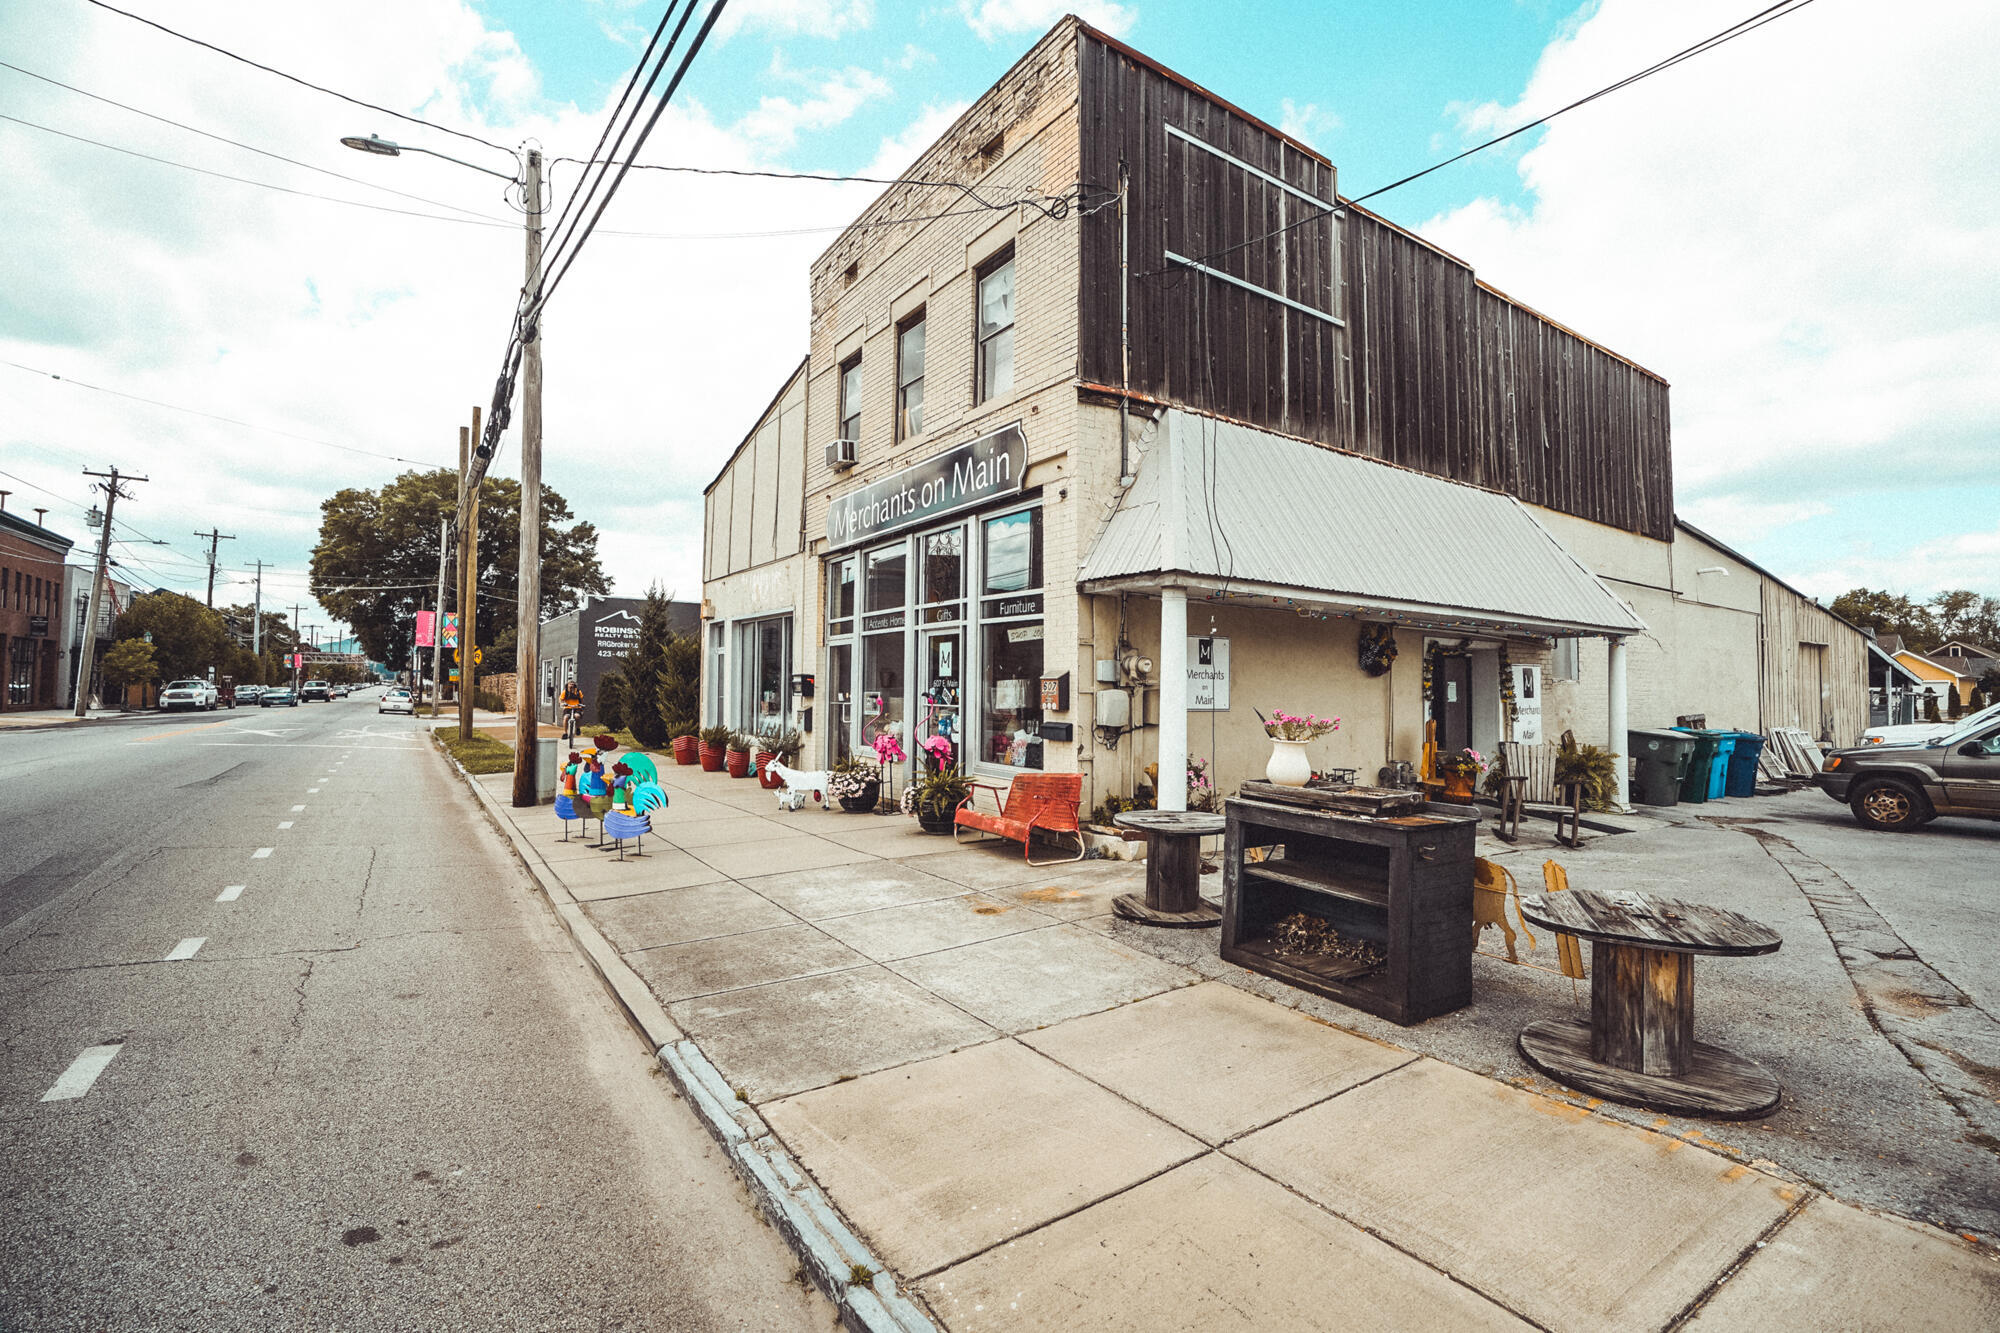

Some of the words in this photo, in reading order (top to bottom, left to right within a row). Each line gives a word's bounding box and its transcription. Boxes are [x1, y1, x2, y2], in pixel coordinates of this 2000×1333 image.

[834, 485, 916, 539] Merchants
[921, 477, 945, 508] on
[952, 447, 1010, 498] Main
[936, 608, 952, 621] Gifts
[1000, 600, 1036, 615] Furniture
[868, 617, 889, 629] Accents
[941, 650, 951, 669] M
[1200, 644, 1210, 660] M
[1187, 669, 1225, 680] Merchants
[1524, 674, 1533, 692] M
